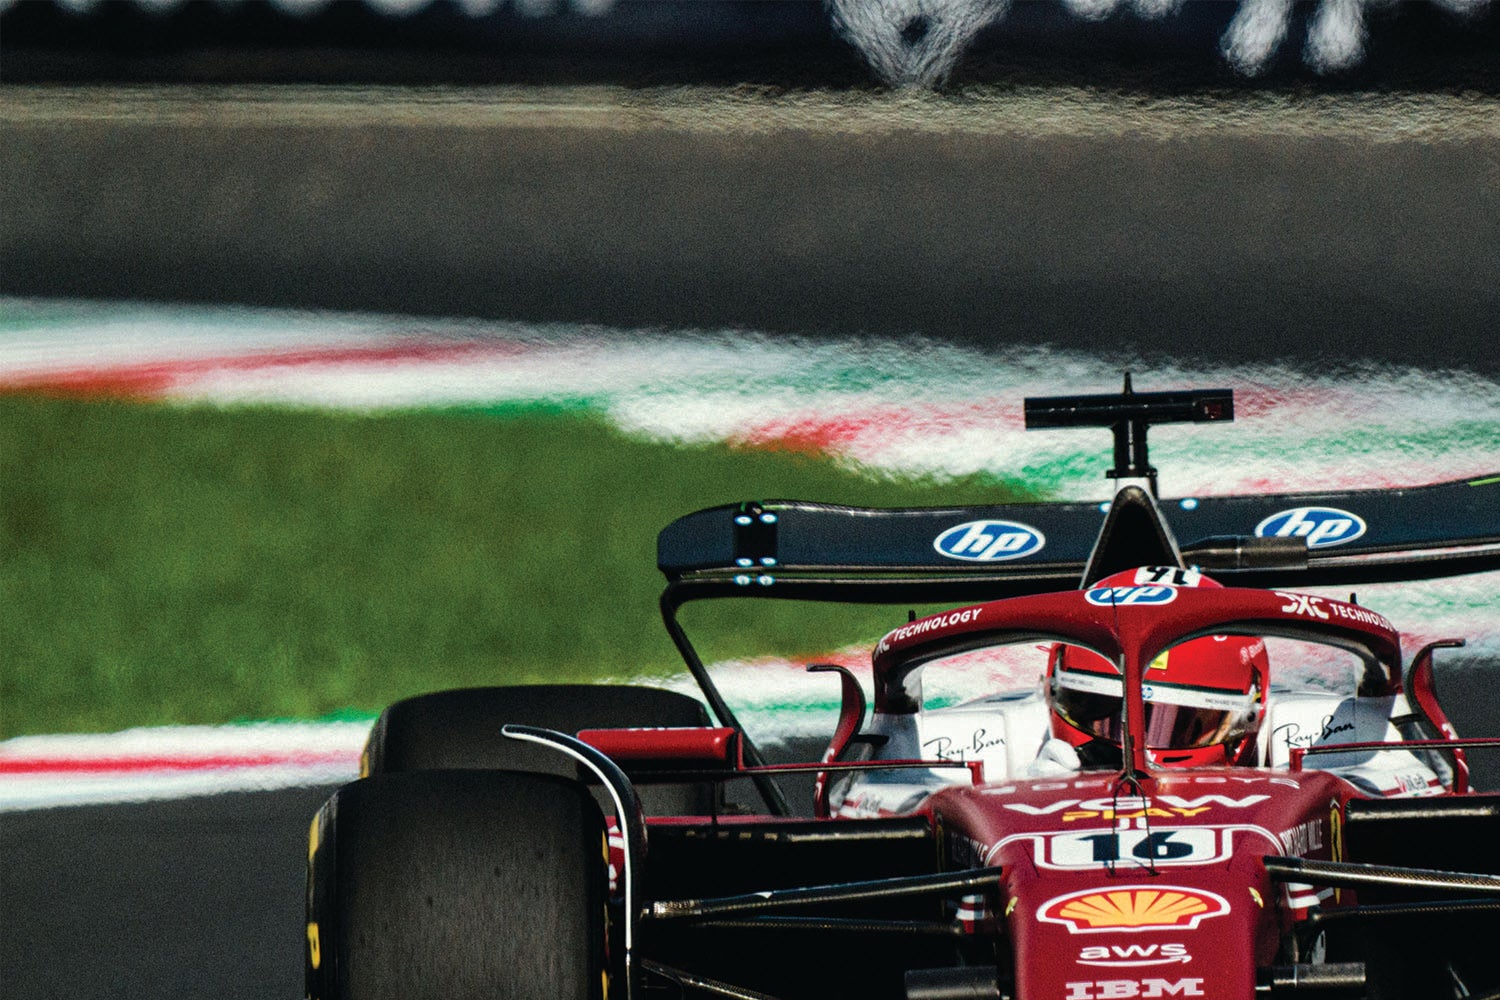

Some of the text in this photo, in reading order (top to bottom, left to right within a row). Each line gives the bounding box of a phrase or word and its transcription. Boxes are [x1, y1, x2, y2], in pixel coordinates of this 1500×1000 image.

[949, 521, 1021, 561] hp
[1275, 508, 1353, 548] hp
[893, 608, 982, 642] TECHNOLOGY
[923, 729, 1006, 761] Ray-Ban
[1273, 715, 1355, 748] Ray-Ban
[1002, 794, 1272, 815] VGW
[1062, 806, 1212, 822] PLAY
[1075, 830, 1194, 862] 16
[1080, 943, 1188, 960] aws
[1065, 978, 1205, 1000] IBM
